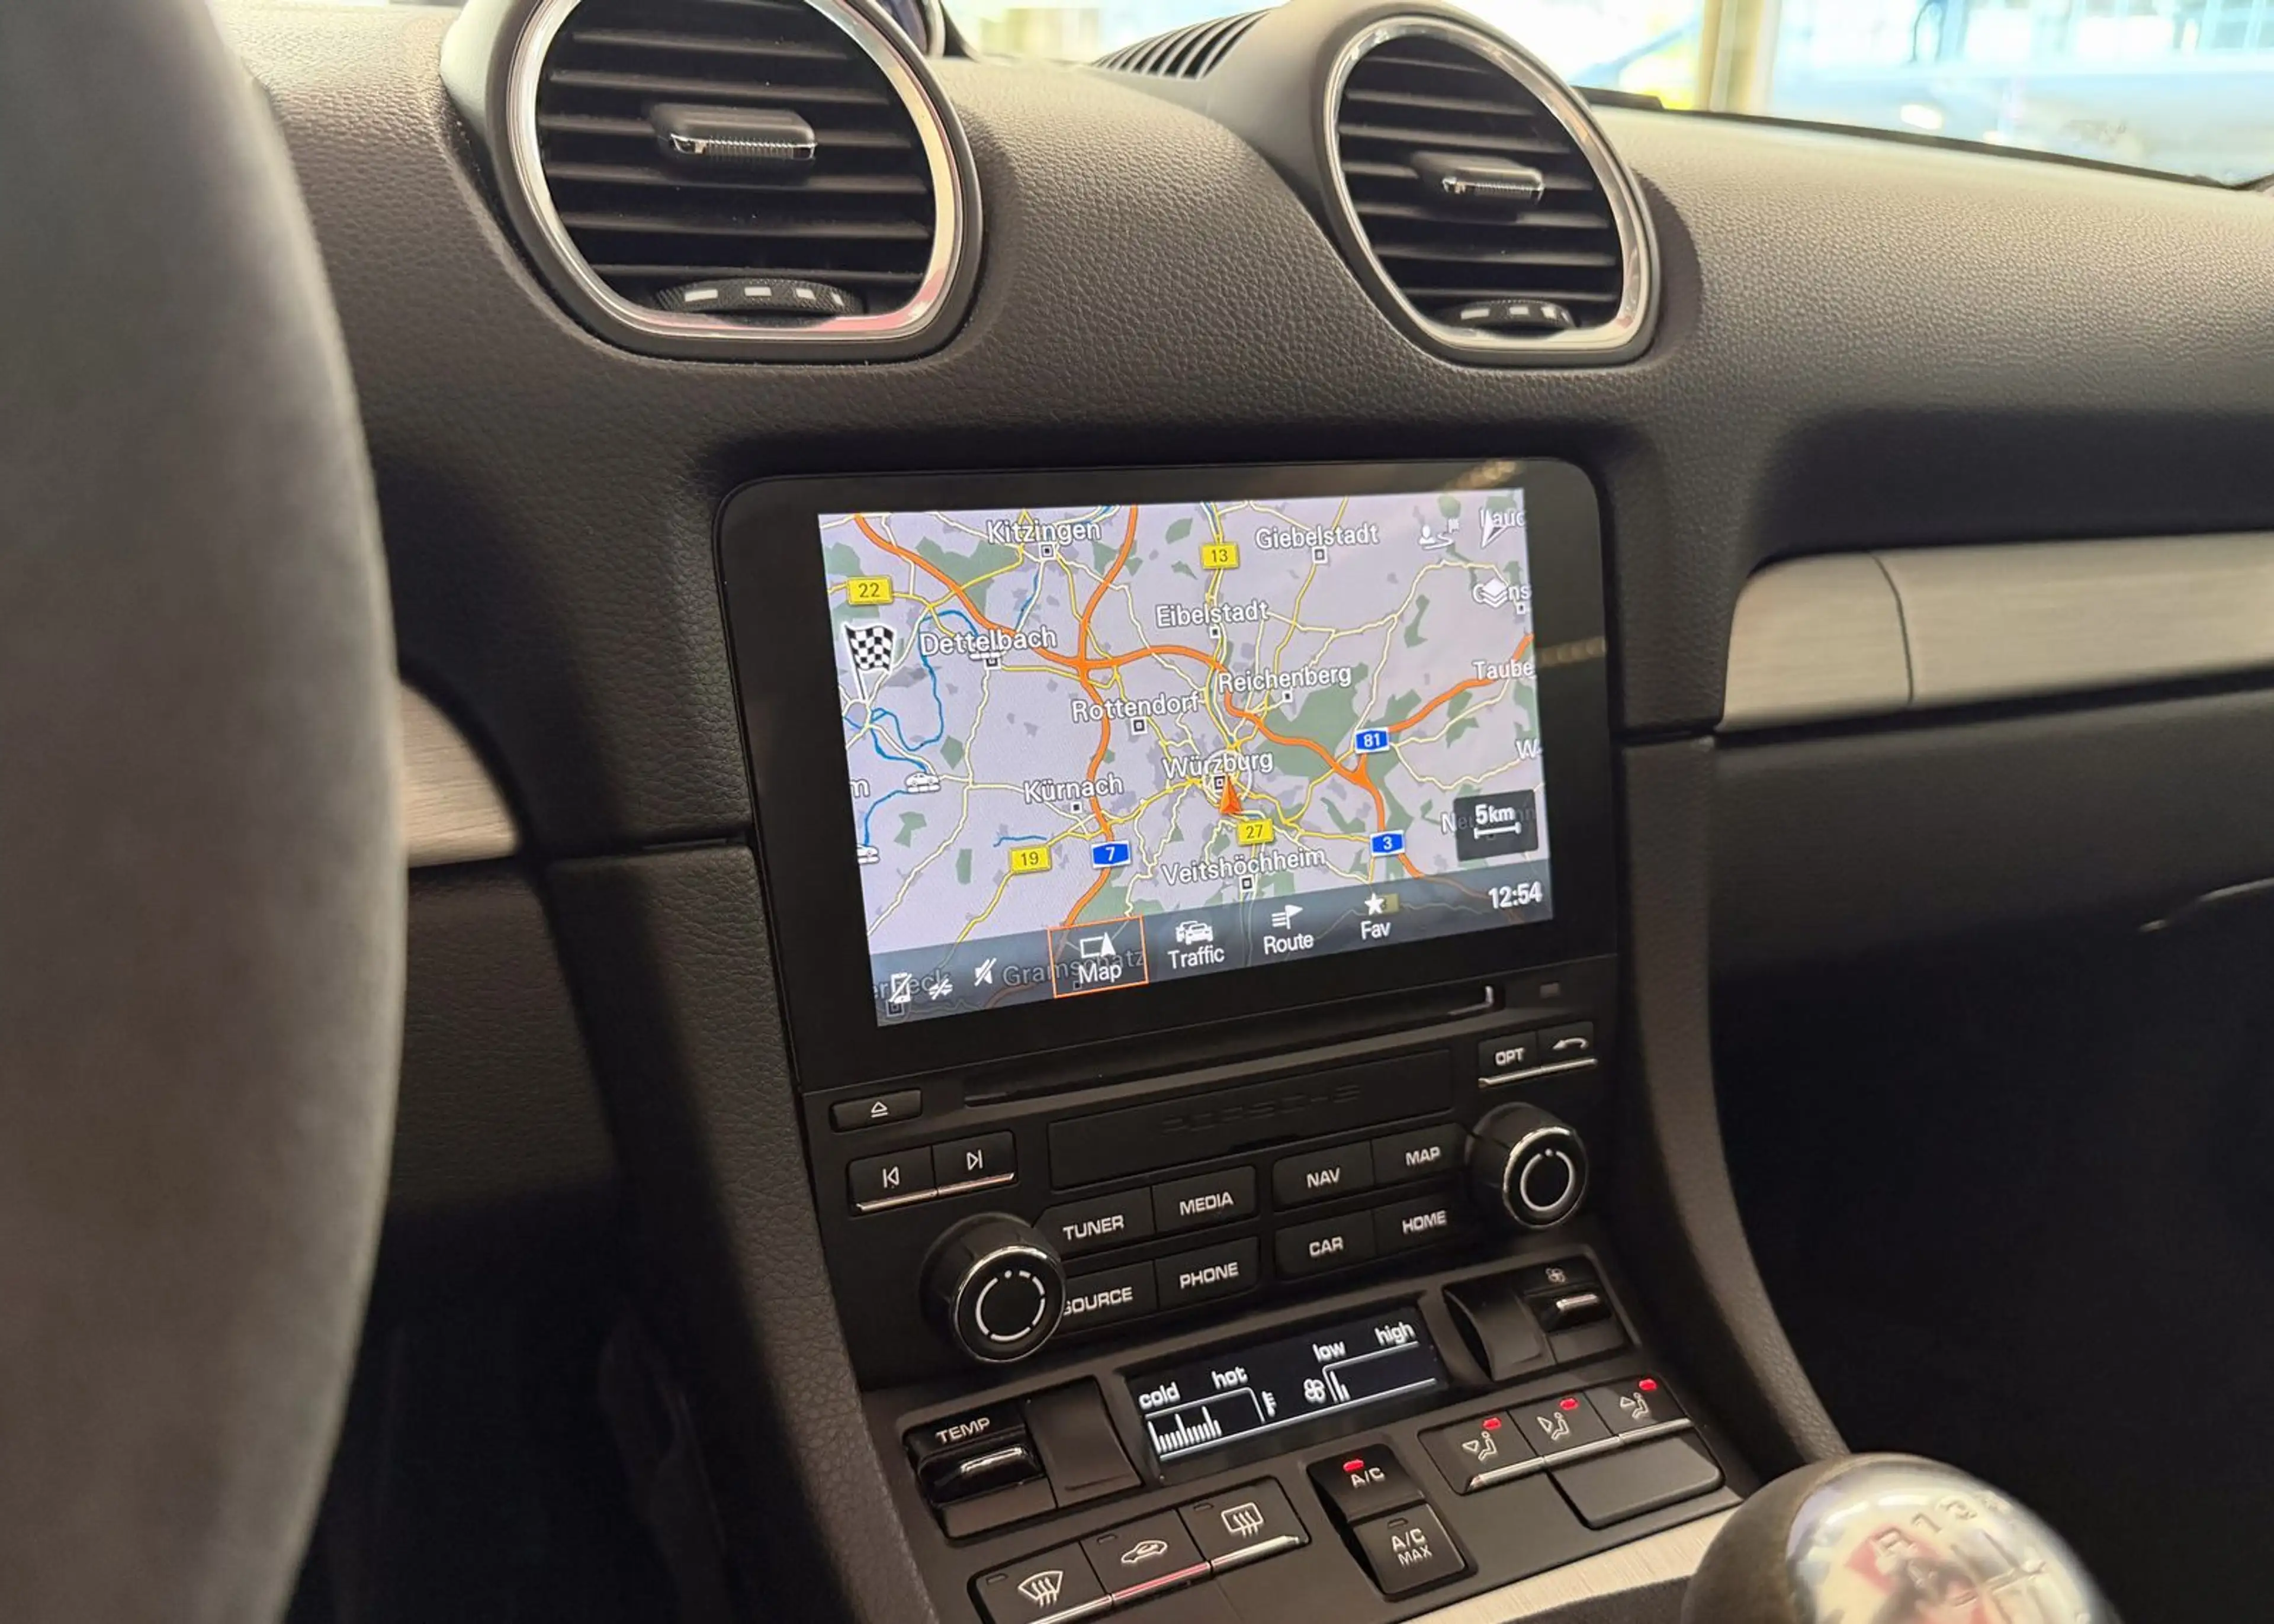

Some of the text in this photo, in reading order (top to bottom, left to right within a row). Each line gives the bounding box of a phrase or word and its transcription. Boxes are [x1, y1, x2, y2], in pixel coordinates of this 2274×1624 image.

[987, 520, 1101, 544] Kitzingen
[1255, 523, 1379, 549] Giebelstadt
[1212, 550, 1228, 562] 13
[858, 582, 880, 598] 22
[1156, 600, 1269, 628] Eibelstadt
[920, 626, 1057, 656] Dettelbach
[1218, 664, 1351, 693] Reichenberg
[1474, 660, 1534, 681] Taube
[1072, 690, 1202, 722] Rottendorf
[1364, 733, 1380, 748] 81
[1162, 752, 1273, 779] Würzburg
[1023, 774, 1124, 805] Kürnach
[1475, 804, 1515, 825] 5km
[1247, 825, 1264, 839] 27
[1383, 837, 1393, 851] 3
[1020, 852, 1039, 866] 19
[1106, 847, 1116, 861] 7
[1162, 847, 1325, 886] Veitshöchheim
[1488, 882, 1543, 910] 12:54
[1361, 920, 1392, 941] Fav
[1264, 933, 1314, 954] Route
[1168, 944, 1225, 970] Traffic
[1078, 964, 1122, 983] Map
[1495, 1047, 1524, 1065] OPT
[1405, 1147, 1441, 1166] MAP
[1307, 1168, 1341, 1189] NAV
[1179, 1191, 1234, 1217] MEDIA
[1063, 1215, 1124, 1241] TUNER
[1402, 1211, 1447, 1235] HOME
[1309, 1237, 1343, 1258] CAR
[1179, 1262, 1239, 1289] PHONE
[1313, 1321, 1417, 1362] low high
[1139, 1366, 1247, 1410] cold hot
[936, 1417, 991, 1445] TEMP
[1351, 1466, 1385, 1488] A/C
[1392, 1527, 1427, 1552] A/C
[1398, 1544, 1433, 1567] MAX
